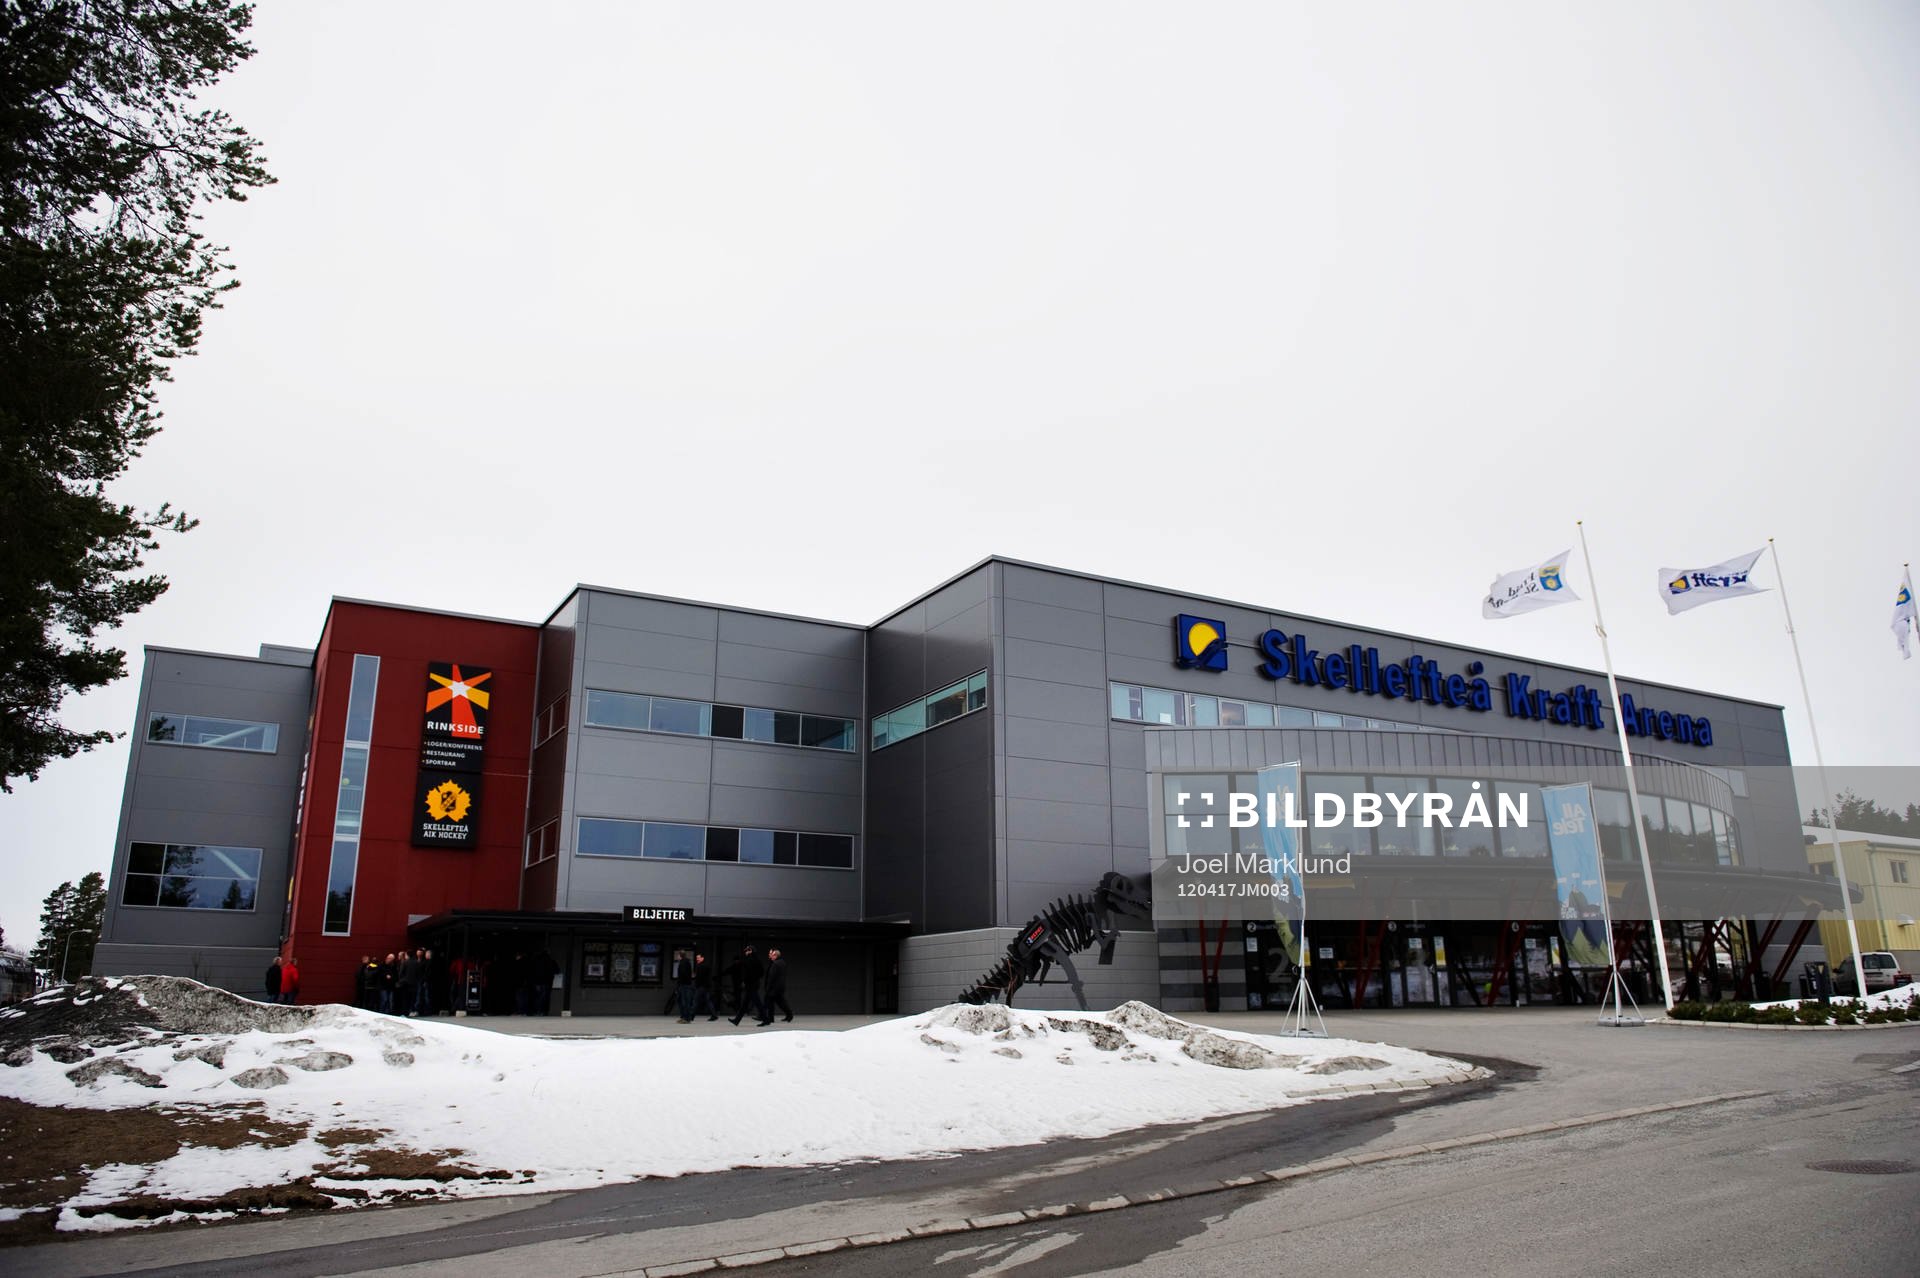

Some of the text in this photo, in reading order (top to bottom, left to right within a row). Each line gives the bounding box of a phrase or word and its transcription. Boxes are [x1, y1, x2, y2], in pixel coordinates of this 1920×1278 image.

[1260, 628, 1714, 747] Skellefteå Kraft Arena
[427, 721, 485, 734] RINKSIDE
[426, 759, 456, 767] SPORTBAR
[633, 909, 685, 920] BILJETTER
[1267, 947, 1293, 984] 2
